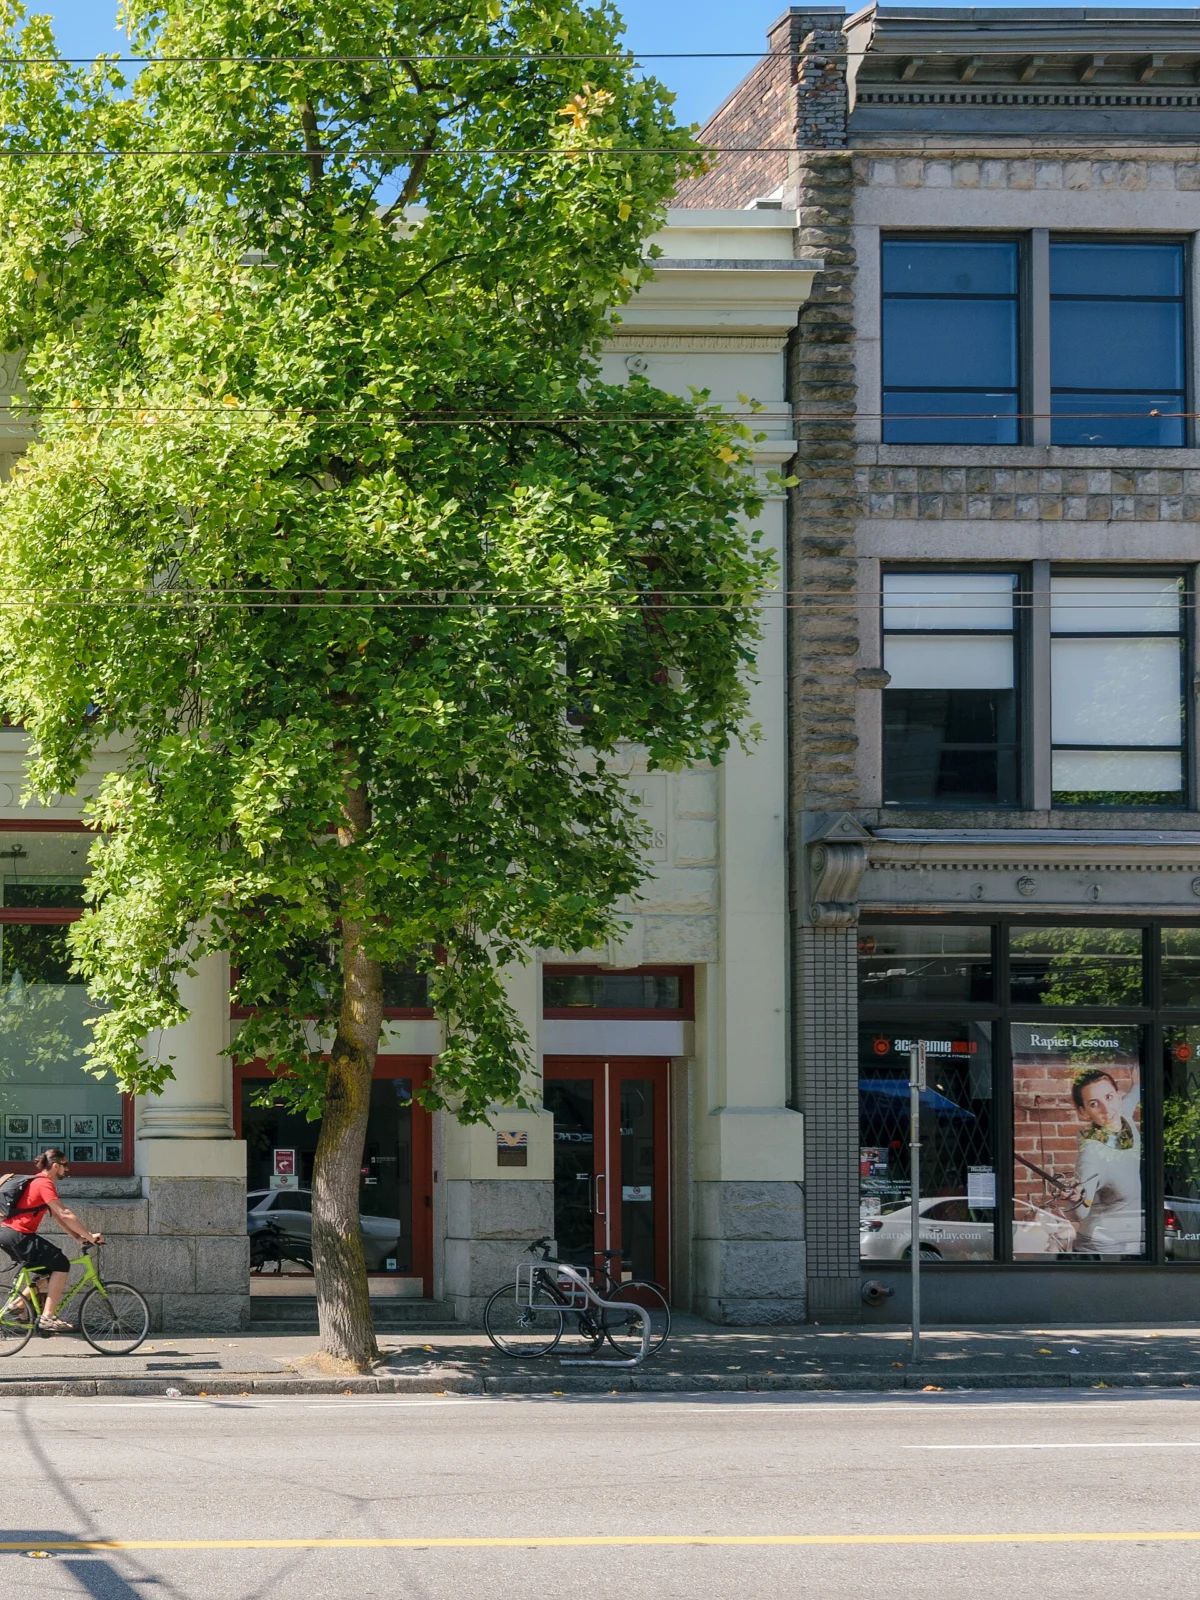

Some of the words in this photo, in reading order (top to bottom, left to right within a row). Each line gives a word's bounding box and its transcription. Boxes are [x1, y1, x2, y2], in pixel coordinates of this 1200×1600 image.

[1030, 1034, 1069, 1050] Rapier
[1072, 1035, 1119, 1048] Lessons
[873, 1229, 981, 1243] LearnSordplay.com
